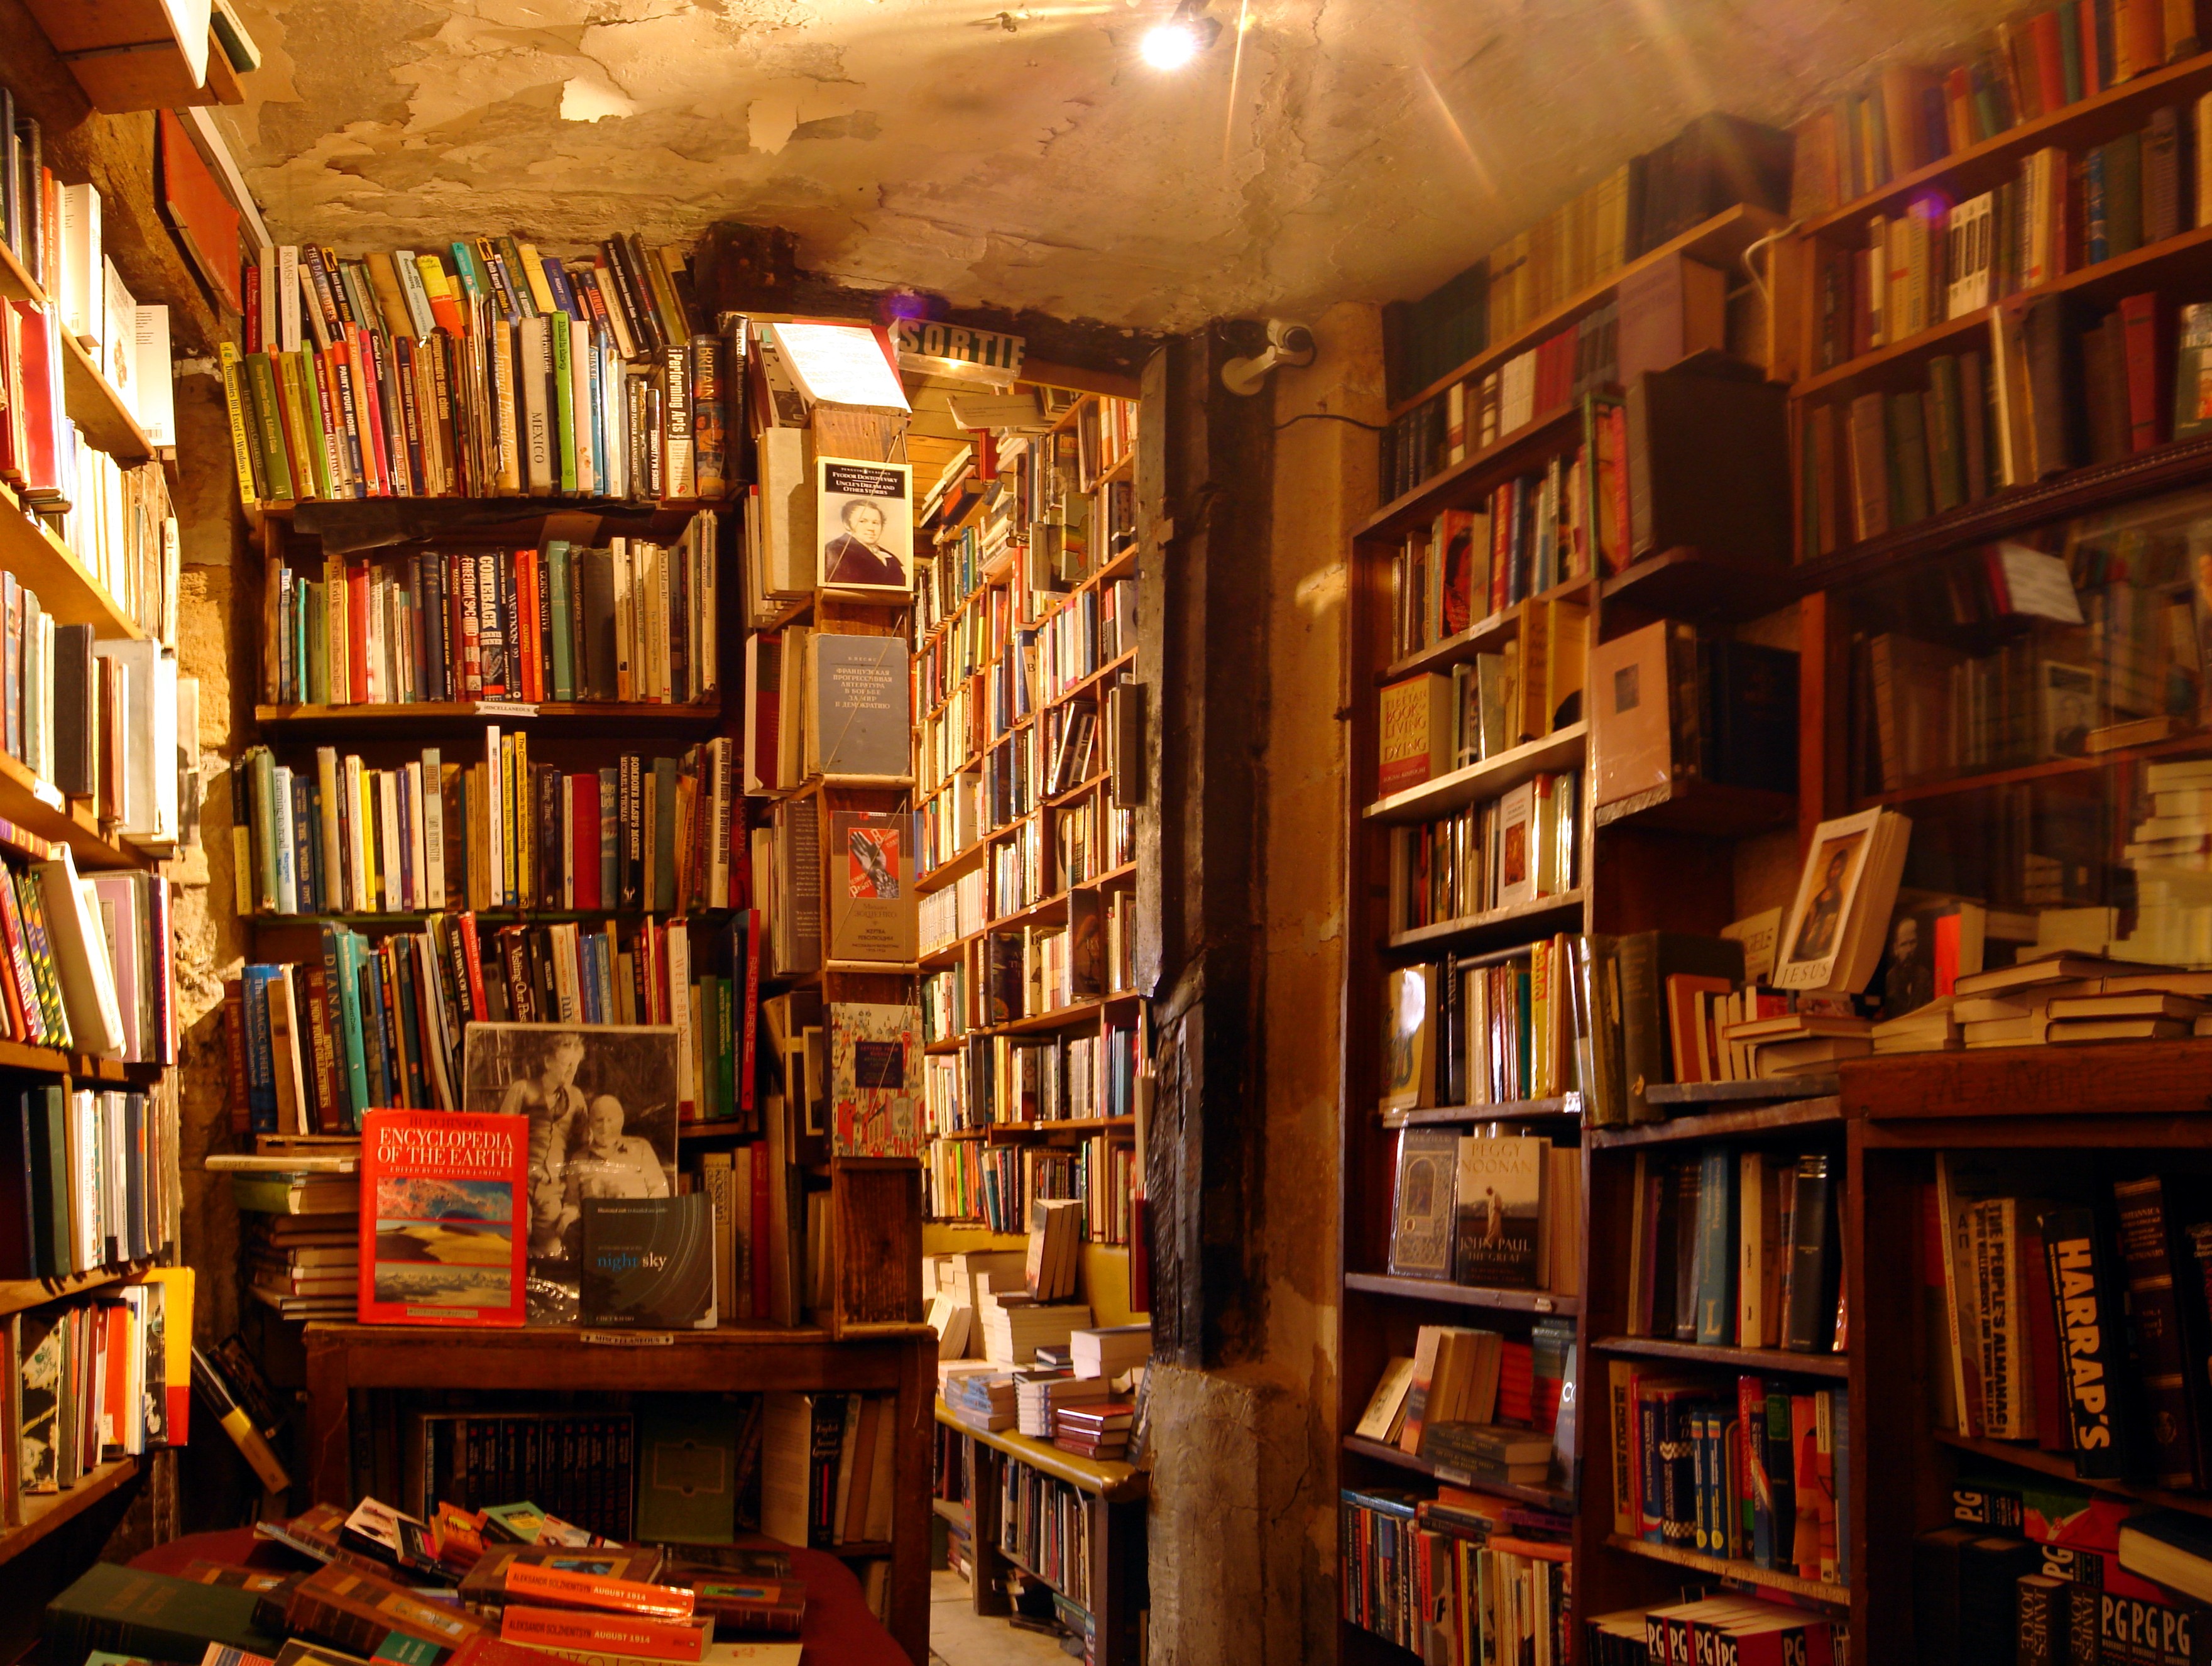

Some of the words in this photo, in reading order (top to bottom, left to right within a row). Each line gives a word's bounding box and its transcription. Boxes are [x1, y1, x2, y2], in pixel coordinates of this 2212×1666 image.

[307, 247, 319, 263] THE
[283, 251, 294, 287] RAMSES
[312, 266, 326, 281] DAY
[414, 275, 422, 288] 2000
[555, 278, 565, 294] RIGHT
[317, 284, 336, 321] TRADERS
[347, 326, 356, 344] INLINE
[372, 336, 382, 359] Colourful
[899, 319, 1026, 373] SORTIE
[431, 334, 446, 380] comprendre
[226, 365, 236, 397] Dummies
[339, 366, 349, 389] PAINT
[403, 367, 412, 395] WORKING
[496, 352, 512, 395] Animal
[668, 354, 686, 408] Performing
[698, 348, 714, 400] BRITAIN
[342, 390, 352, 412] YOUR
[437, 381, 446, 396] son
[229, 398, 239, 414] 101:
[439, 397, 450, 419] chien
[233, 414, 242, 430] Excel
[346, 414, 356, 436] HOME
[407, 408, 417, 441] TOGETHER
[499, 400, 517, 463] Physiology
[670, 410, 687, 432] Arts
[532, 412, 544, 464] MEXICO
[236, 440, 247, 474] Windows
[832, 471, 857, 480] FYODOR
[539, 571, 548, 598] GOING
[572, 565, 582, 592] Television
[479, 556, 497, 629] COMEBACK
[541, 602, 550, 632] NATIVE
[573, 593, 583, 621] Graphics
[464, 610, 478, 637] CHILD
[483, 704, 531, 713] MISCELLANEOUS
[841, 701, 891, 710] ДЕМОКРАТИЮ
[1386, 689, 1427, 708] TIBETAN
[1384, 717, 1427, 740] LIVING
[1386, 705, 1417, 725] BOOK
[719, 742, 731, 763] Journey
[1383, 740, 1427, 762] DYING
[631, 756, 639, 797] SOMEONE
[720, 764, 730, 782] Across
[275, 772, 287, 815] Learning
[631, 799, 640, 827] ELSE'S
[720, 806, 730, 816] The
[278, 828, 289, 849] read
[519, 814, 527, 853] Windsurfing
[631, 829, 640, 861] MONEY
[720, 833, 729, 848] Union
[429, 833, 440, 863] BERNSTEIN
[451, 930, 461, 948] THE
[11, 943, 31, 1009] ПУШКИН
[511, 945, 523, 983] Visiting
[748, 956, 758, 992] RALPH
[255, 978, 264, 1002] THE
[325, 952, 342, 1019] DIANA
[515, 982, 527, 1003] Our
[674, 956, 689, 1048] WELL-BEING
[745, 995, 756, 1039] LAUREN
[312, 1024, 322, 1046] YOUR
[380, 1127, 513, 1149] ENCYCLOPEDIA
[1471, 1142, 1523, 1159] PEGGY
[377, 1146, 403, 1163] OF
[407, 1147, 446, 1166] THE
[450, 1149, 513, 1168] EARTH
[1461, 1158, 1533, 1175] NOONAN
[1988, 1203, 2004, 1238] THE
[1459, 1236, 1493, 1252] JOHN
[1497, 1237, 1531, 1252] PAUL
[1489, 1252, 1521, 1263] GREAT
[597, 1252, 638, 1272] night
[642, 1251, 667, 1272] sky
[1989, 1242, 2007, 1329] PEOPLE'S
[2057, 1237, 2111, 1451] HARRAP'S
[1993, 1333, 2008, 1426] ALMANAC
[512, 1571, 547, 1587] ALEKSANDR
[549, 1577, 592, 1594] SOLZHENITSYN
[593, 1585, 625, 1599] AUGUST
[626, 1591, 646, 1601] 1914
[2020, 1586, 2034, 1650] JOYCE
[2034, 1587, 2047, 1657] JAMES
[2070, 1590, 2082, 1655] JOYCE
[2081, 1592, 2094, 1663] JAMES
[547, 1623, 591, 1639] SOLZHENITSYN
[594, 1630, 627, 1643] AUGUST
[628, 1633, 650, 1645] 1914
